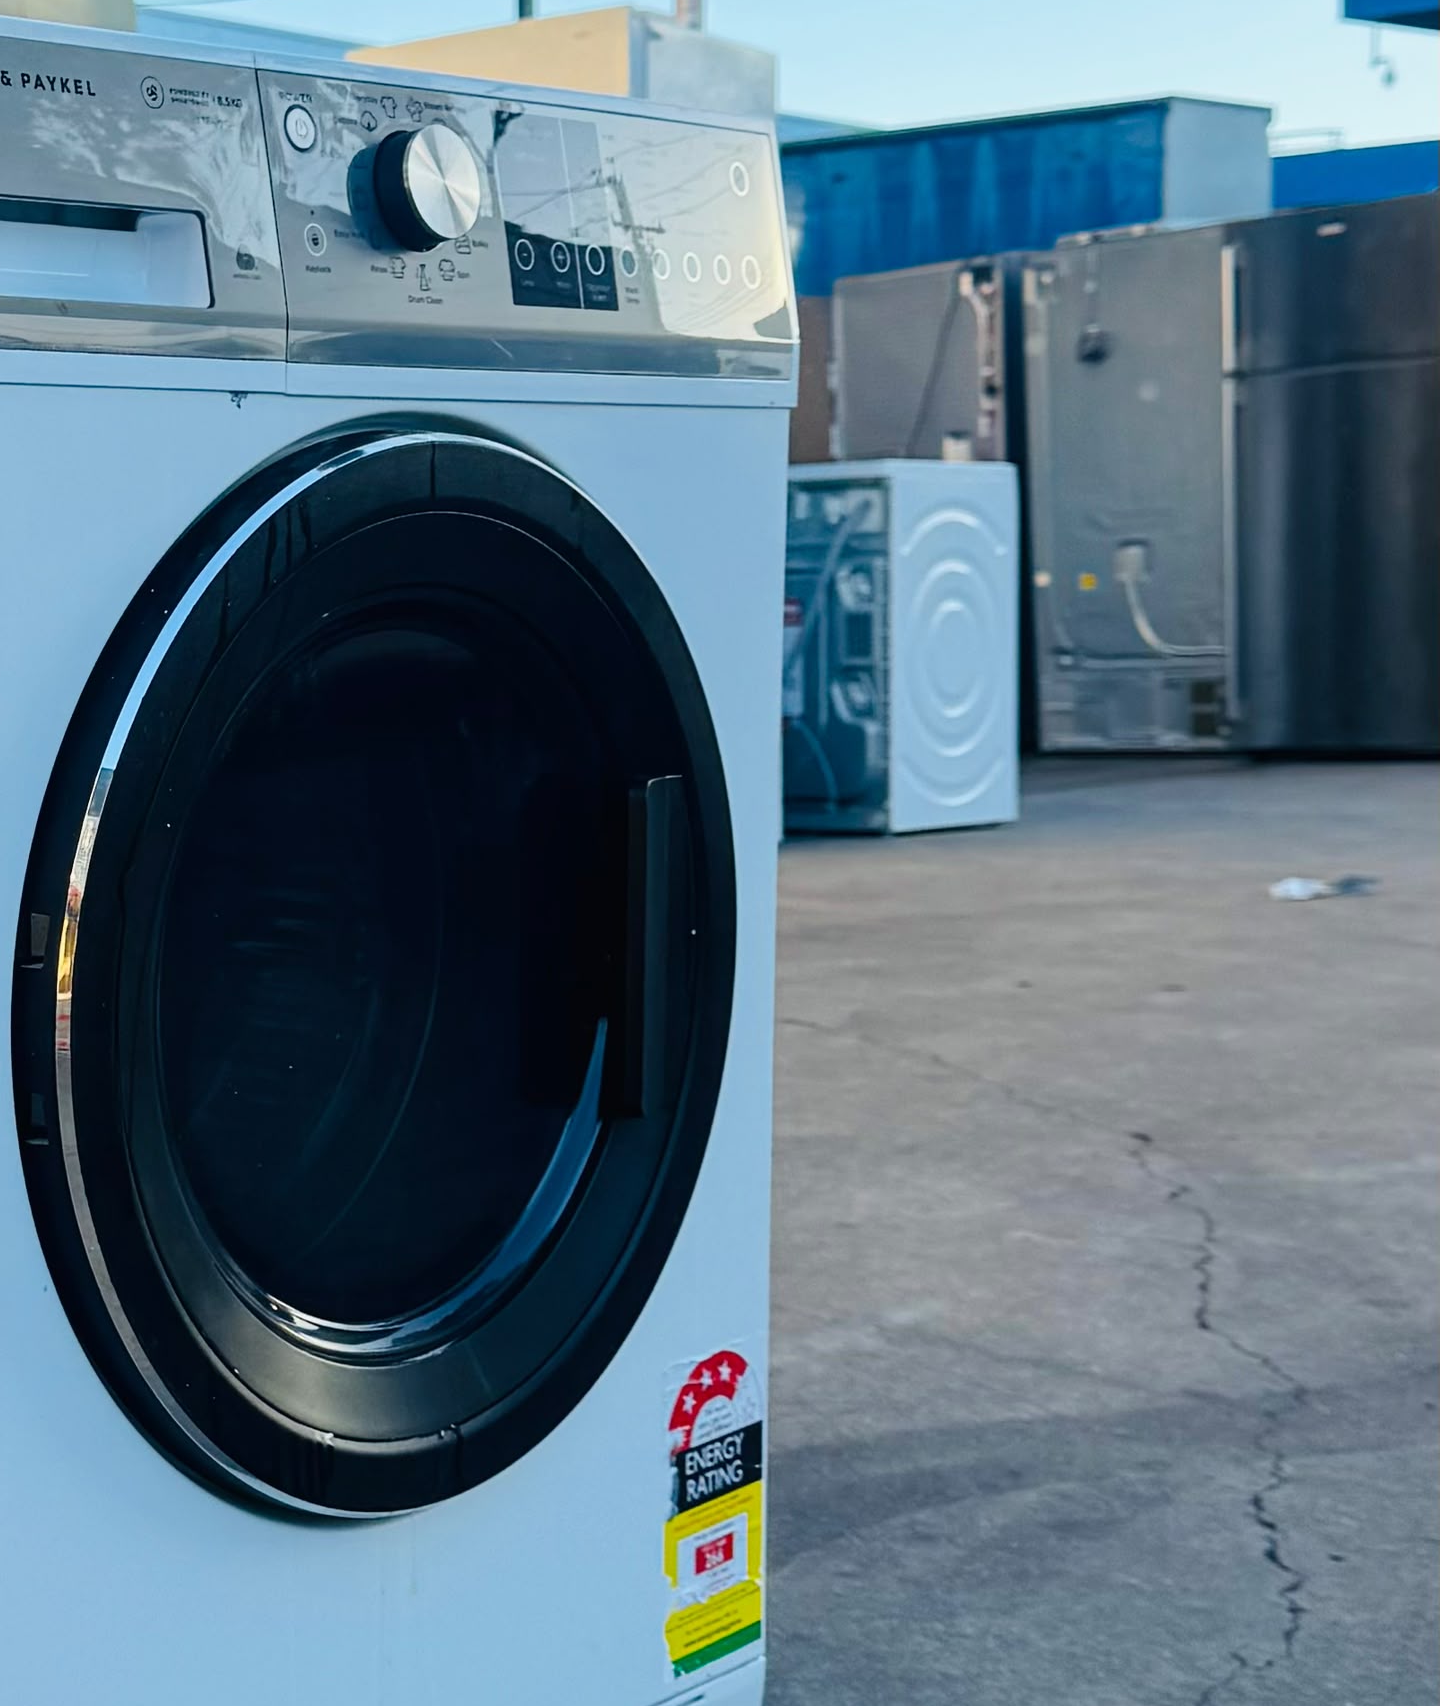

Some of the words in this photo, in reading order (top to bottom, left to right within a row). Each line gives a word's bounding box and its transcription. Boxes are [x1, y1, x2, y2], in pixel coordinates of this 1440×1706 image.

[0, 70, 13, 88] &
[21, 73, 98, 98] PAYKEL
[684, 1432, 744, 1476] ENERGY
[685, 1459, 744, 1503] RATING
